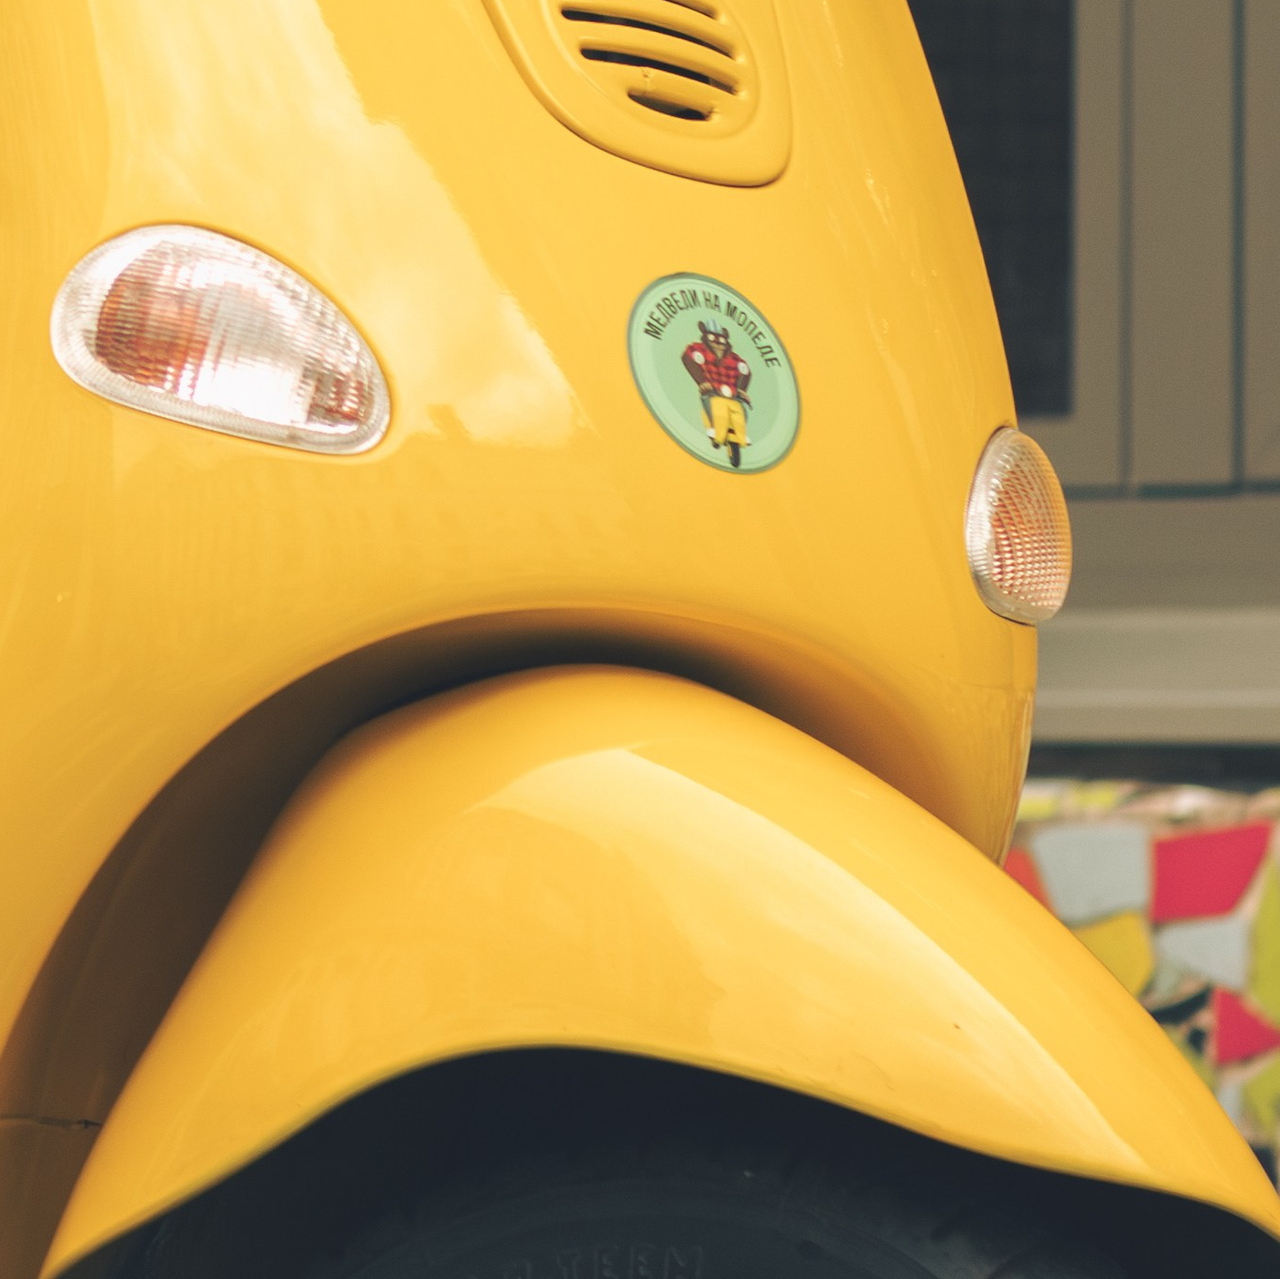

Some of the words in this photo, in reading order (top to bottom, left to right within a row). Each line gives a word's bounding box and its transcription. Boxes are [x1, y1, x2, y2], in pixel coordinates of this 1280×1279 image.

[643, 289, 701, 341] МЕДВЕДИ
[702, 289, 722, 313] НА
[725, 301, 782, 368] МОПЕДЕ
